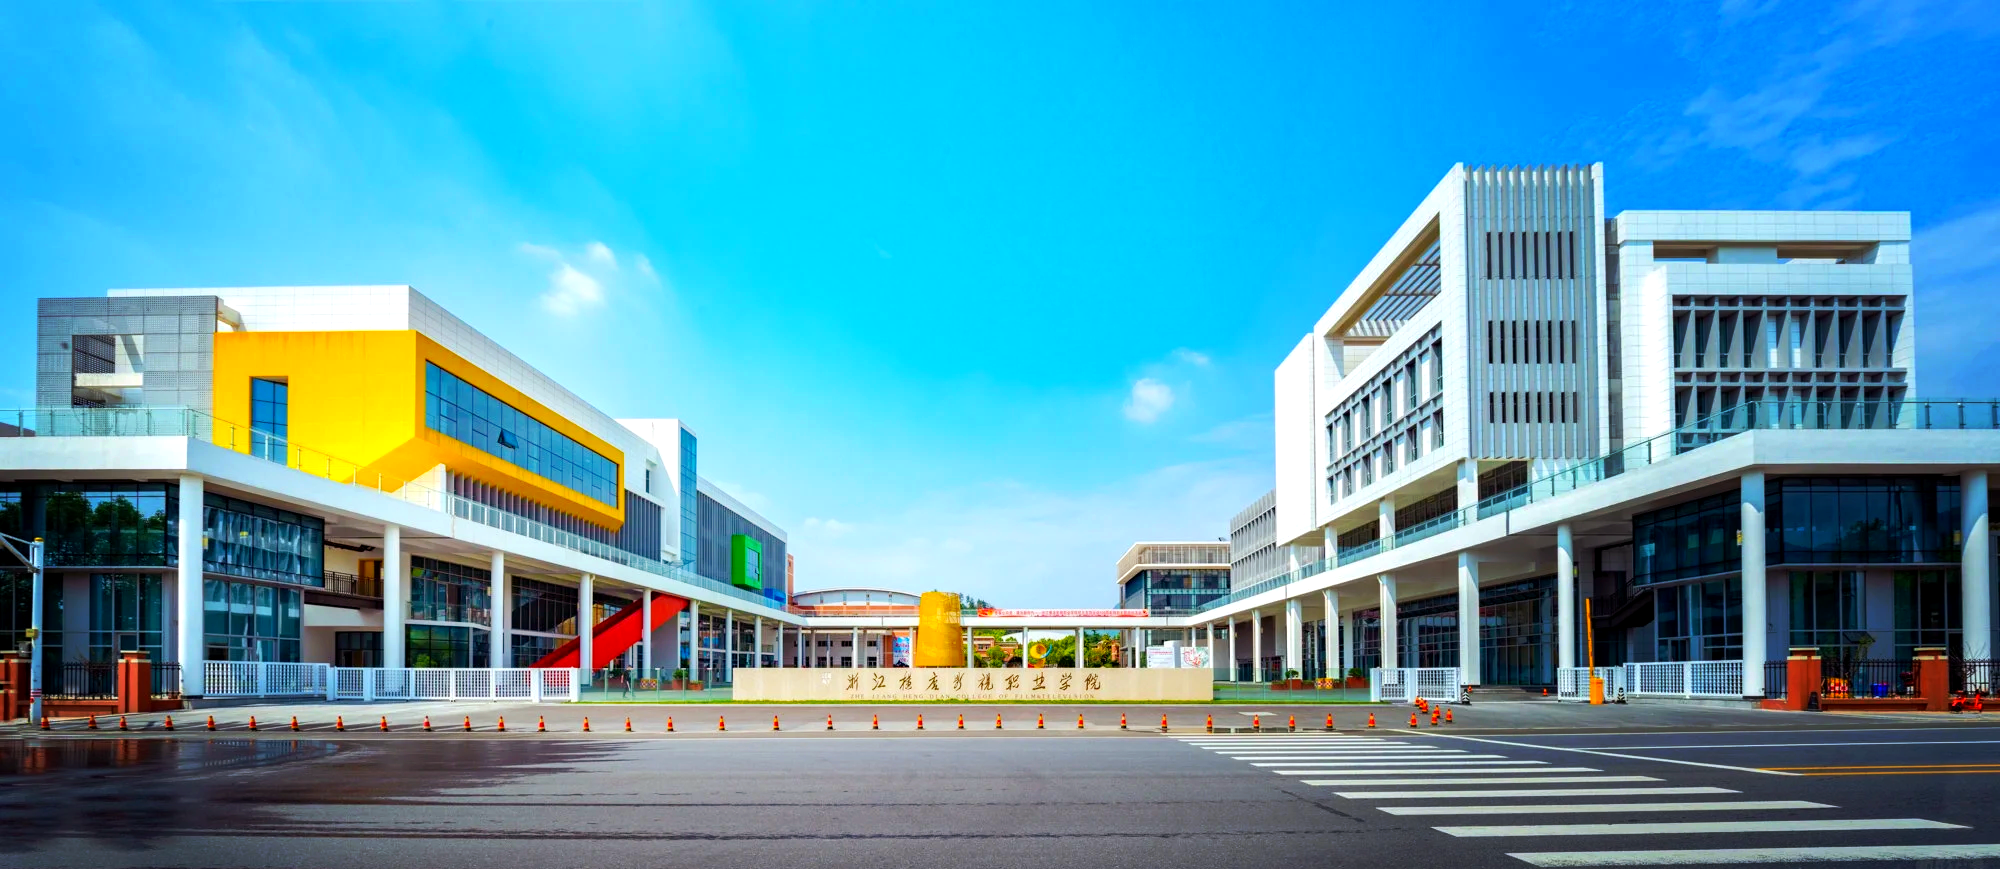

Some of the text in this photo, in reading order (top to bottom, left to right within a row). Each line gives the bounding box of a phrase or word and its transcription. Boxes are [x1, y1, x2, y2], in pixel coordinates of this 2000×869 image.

[845, 671, 1101, 691] 浙江横店影视职业学院
